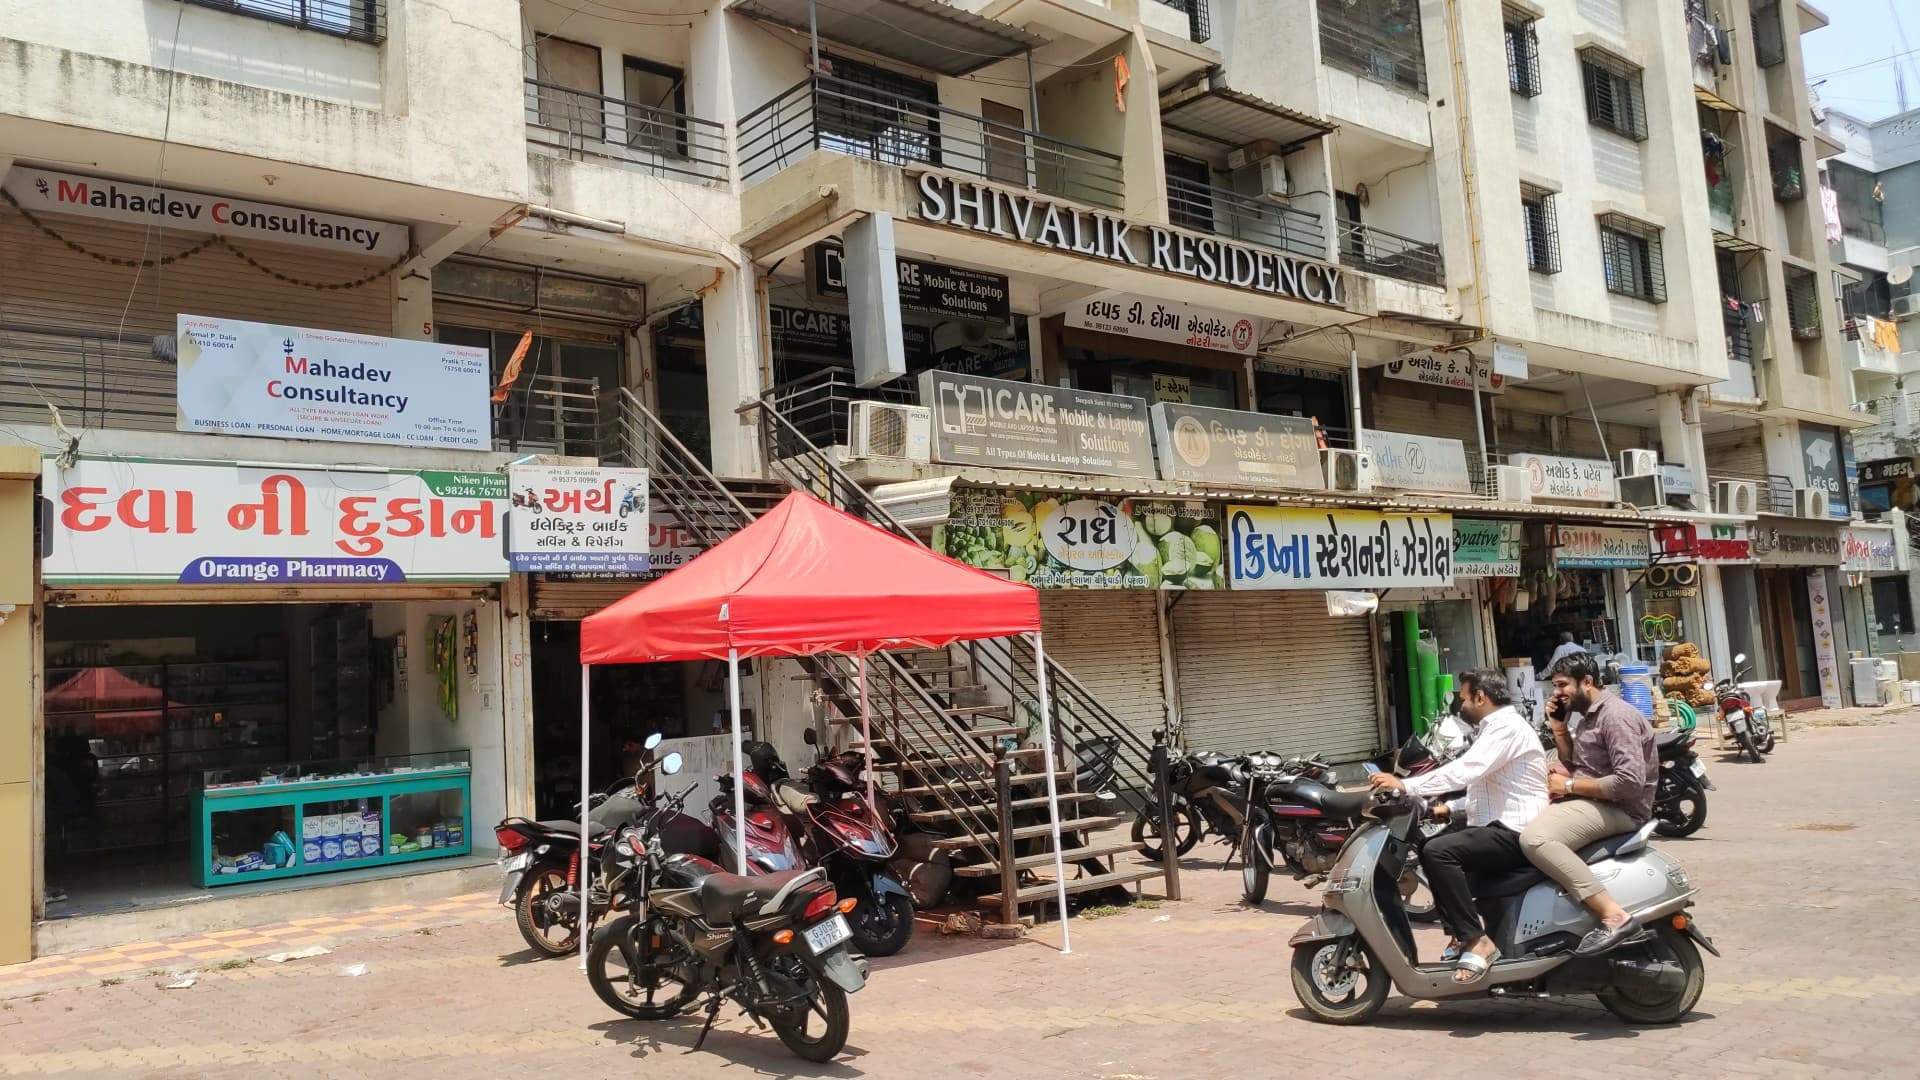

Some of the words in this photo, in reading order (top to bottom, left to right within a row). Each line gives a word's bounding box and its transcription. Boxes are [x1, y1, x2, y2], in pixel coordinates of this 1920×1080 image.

[57, 178, 203, 222] Mahadev
[210, 201, 381, 251] Consultancy
[917, 170, 1139, 265] SHIVALIK
[1147, 224, 1346, 305] RESIDENCY
[923, 274, 957, 290] Mobile
[959, 280, 968, 293] &
[970, 282, 1003, 302] Laptop
[941, 293, 988, 312] Solutions
[423, 322, 432, 335] 5
[785, 308, 838, 335] ICARE
[285, 355, 392, 383] Mahadev
[1408, 355, 1442, 372] અશોક
[267, 380, 409, 413] Consultancy
[986, 387, 1057, 425] ICARE
[194, 419, 230, 428] BUSINESS
[231, 421, 251, 430] LOAN
[257, 423, 294, 432] PERSONAL
[295, 425, 315, 433] LOAN
[321, 427, 382, 439] HOME/MORTGAGE
[382, 432, 401, 440] LOAN
[406, 433, 416, 441] CC
[416, 434, 434, 442] LOAN
[439, 436, 461, 444] CREDIT
[461, 437, 479, 446] CARD
[1058, 407, 1095, 428] Mobile
[1096, 414, 1107, 429] &
[1108, 414, 1145, 437] Laptop
[1080, 432, 1130, 455] Solutions
[985, 446, 996, 457] All
[996, 447, 1017, 459] Types
[1026, 450, 1050, 461] Mobile
[1057, 453, 1080, 465] Laptop
[1082, 455, 1112, 467] Solutions
[444, 486, 476, 496] 98246
[478, 487, 508, 497] 76701
[453, 475, 481, 485] Niken
[482, 476, 507, 486] Jivani
[1828, 477, 1839, 492] Go
[543, 479, 617, 514] અર્થ
[60, 486, 199, 534] દવા
[226, 474, 311, 536] ની
[335, 496, 497, 557] દુકાન
[592, 520, 629, 533] બાઈક
[571, 537, 581, 547] &
[1316, 513, 1392, 579] સ્ટેશનરી
[1393, 548, 1401, 568] &
[199, 560, 279, 581] Orange
[286, 560, 389, 581] Pharmacy
[705, 932, 729, 941] Shine
